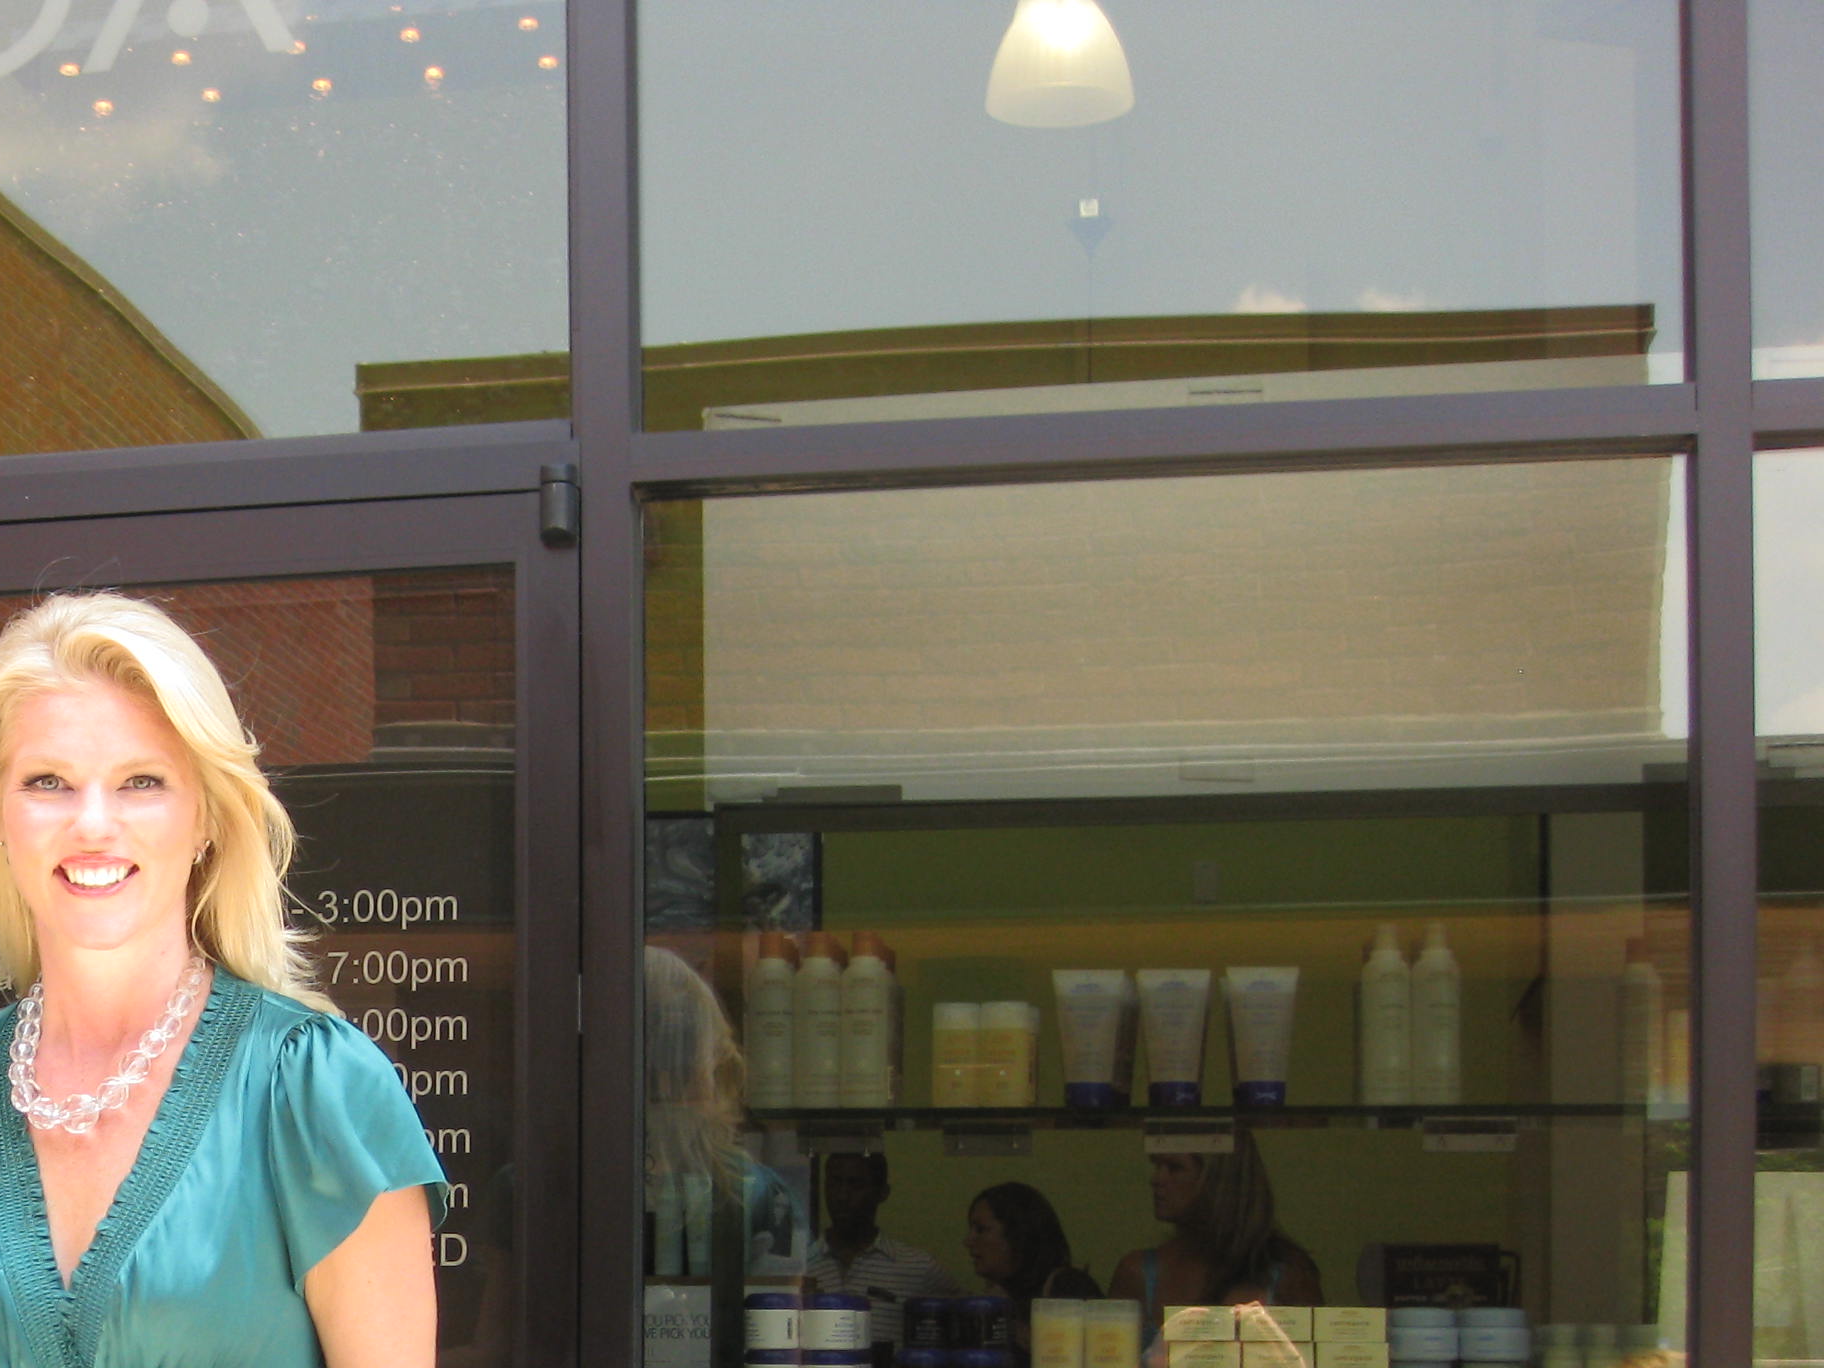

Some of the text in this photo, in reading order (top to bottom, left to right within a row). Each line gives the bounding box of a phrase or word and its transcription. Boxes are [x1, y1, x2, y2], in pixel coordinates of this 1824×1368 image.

[317, 889, 458, 930] 3:00pm
[327, 950, 468, 991] 7:00pm
[353, 1009, 468, 1049] :00pm
